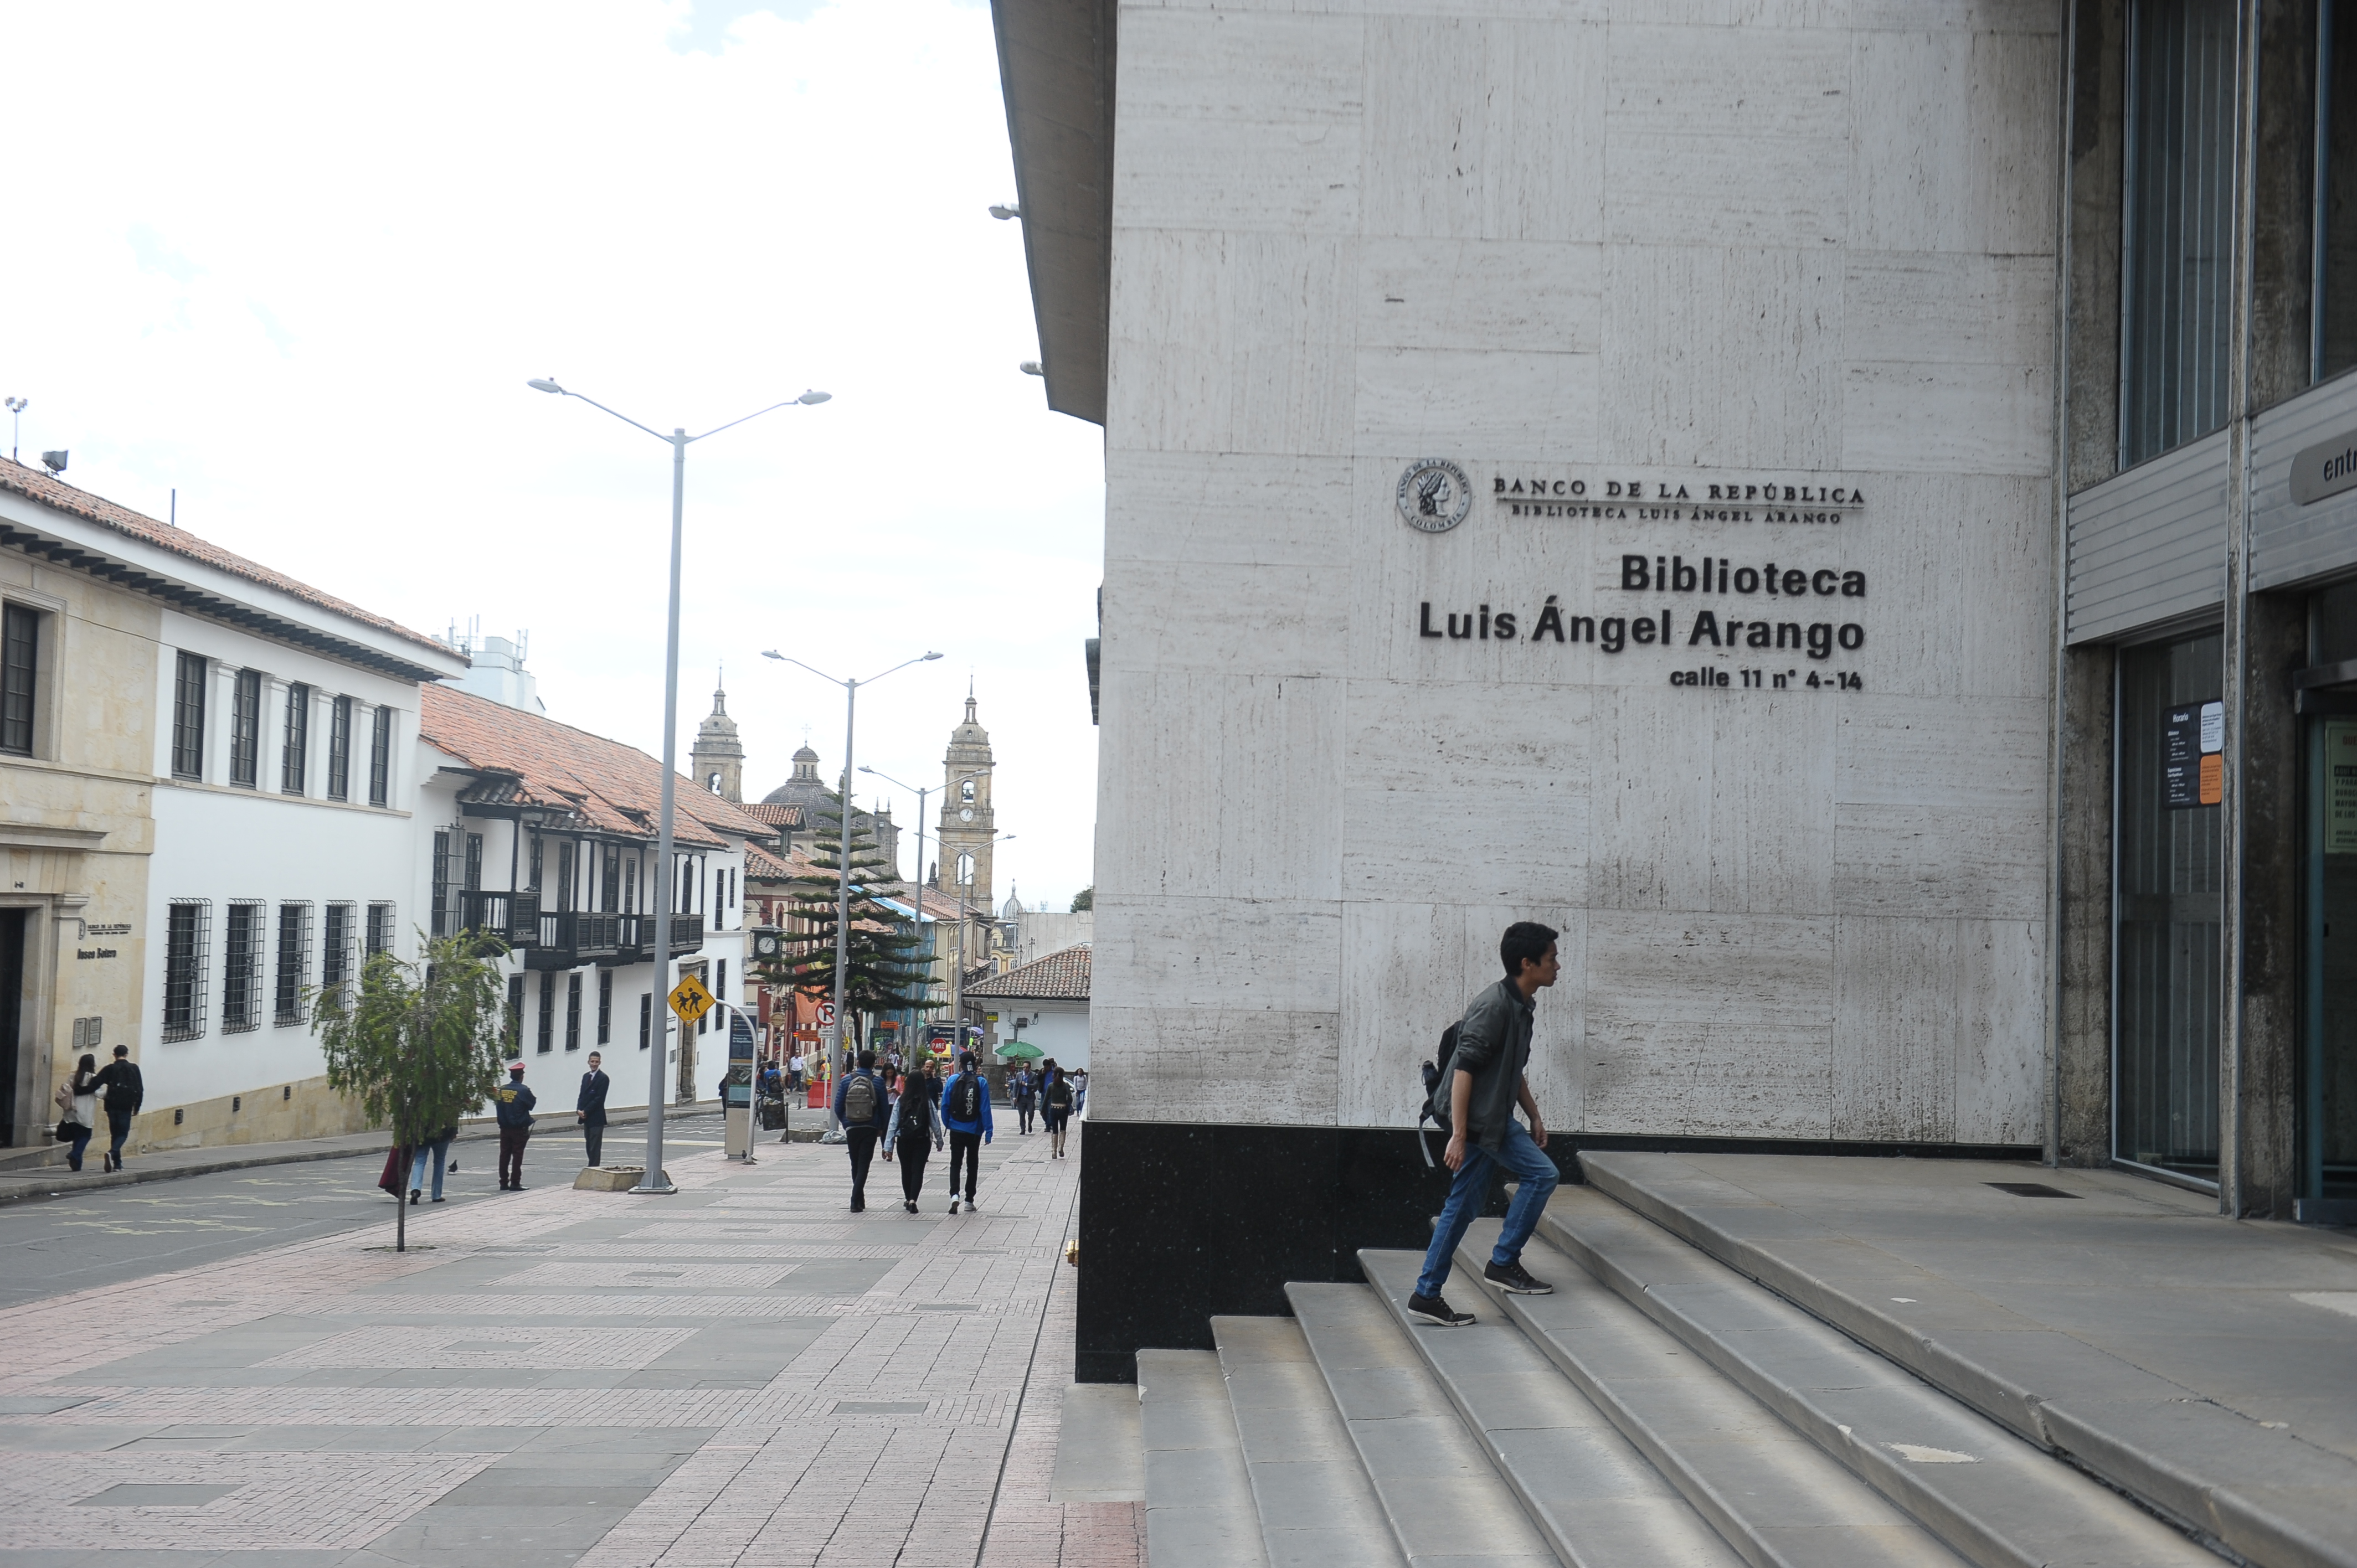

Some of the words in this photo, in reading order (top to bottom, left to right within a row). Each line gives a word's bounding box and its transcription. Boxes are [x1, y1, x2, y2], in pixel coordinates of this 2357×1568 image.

[1399, 472, 1412, 498] BANCO
[1494, 478, 1585, 495] BANCO
[1607, 481, 1641, 497] DE
[1659, 483, 1689, 498] LA
[1709, 482, 1864, 503] REPÚBLICA
[1410, 513, 1462, 530] COLOMBIA
[1512, 504, 1627, 519] BIBLIOTECA
[1639, 508, 1680, 520] LUIS
[1691, 506, 1753, 522] ÁNGEL
[1764, 512, 1840, 524] ARANGO
[1621, 555, 1867, 598] Biblioteca
[1420, 602, 1516, 640] Luis
[1531, 595, 1671, 654] Ángel
[1687, 610, 1865, 660] Arango
[1670, 667, 1730, 687] calle
[1740, 669, 1761, 688] 11
[965, 1088, 974, 1115] adidas
